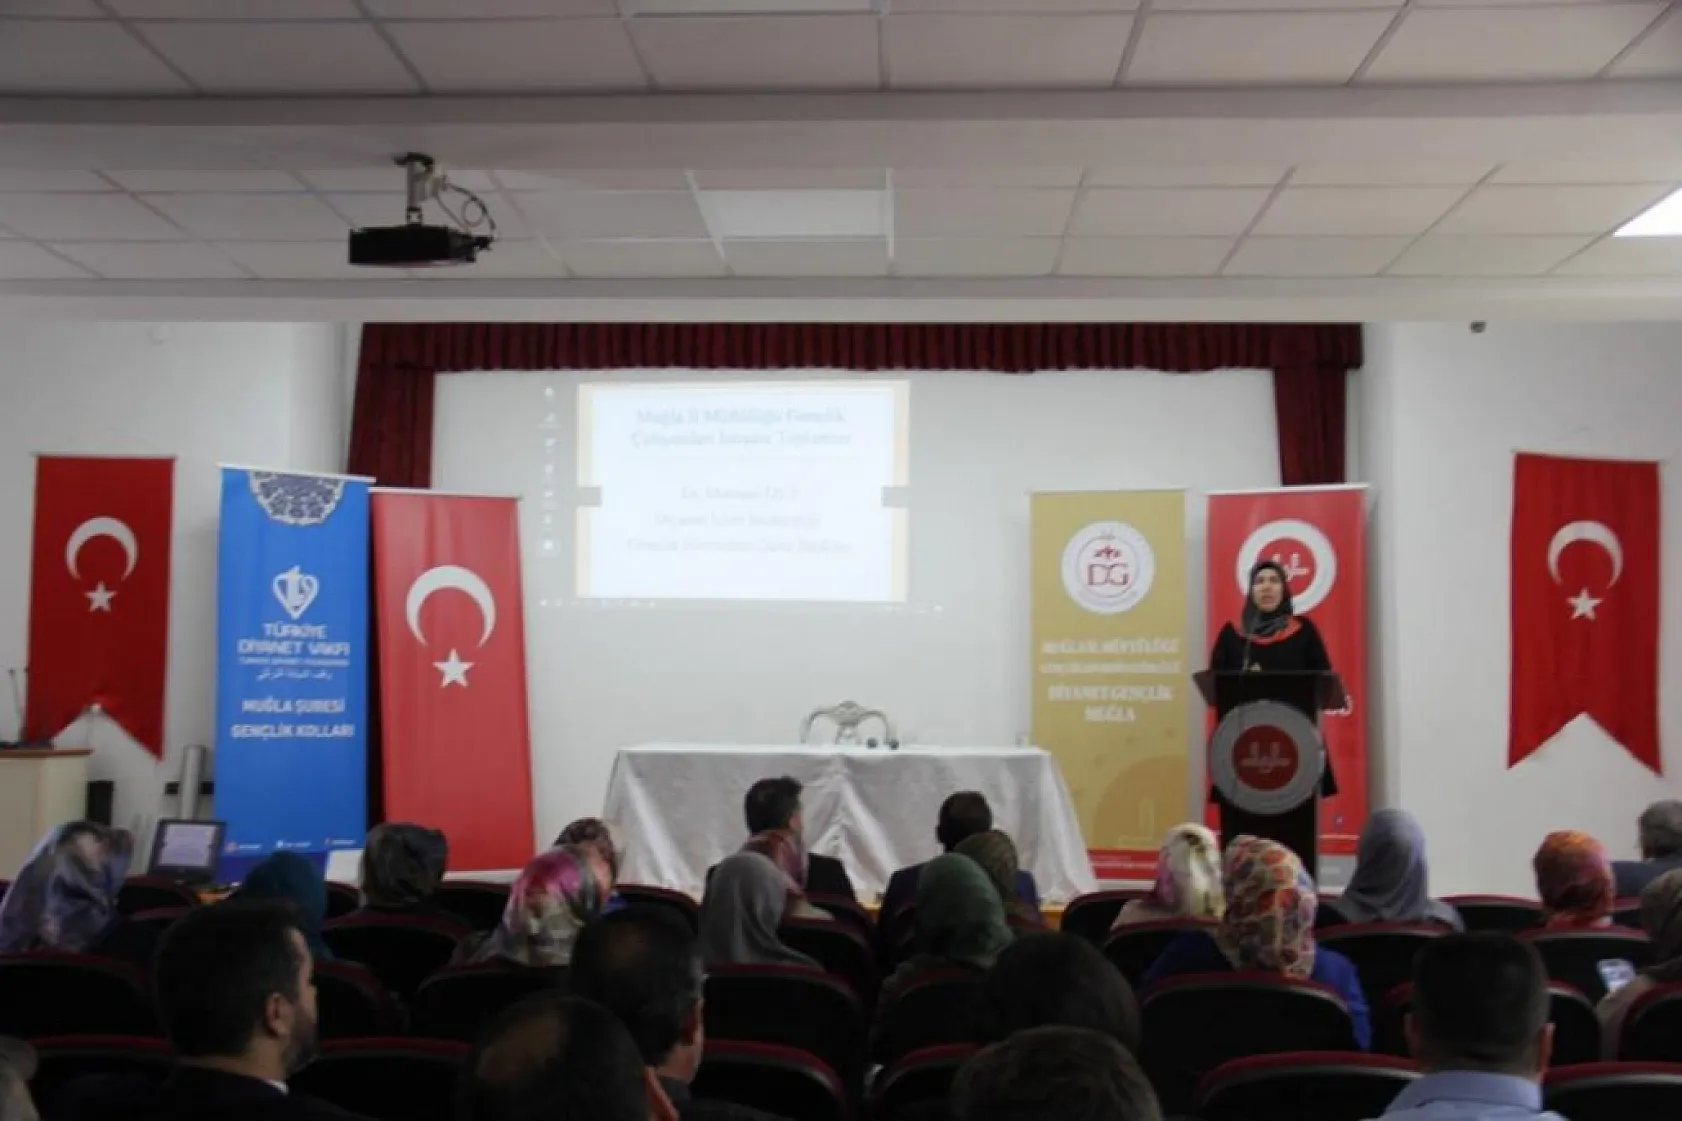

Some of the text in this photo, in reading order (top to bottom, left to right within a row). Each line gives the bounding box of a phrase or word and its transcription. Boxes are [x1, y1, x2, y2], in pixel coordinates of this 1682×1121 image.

[242, 696, 345, 716] MUĞLA ŞUBESİ
[231, 722, 355, 740] GENÇLİK KOLLARI
